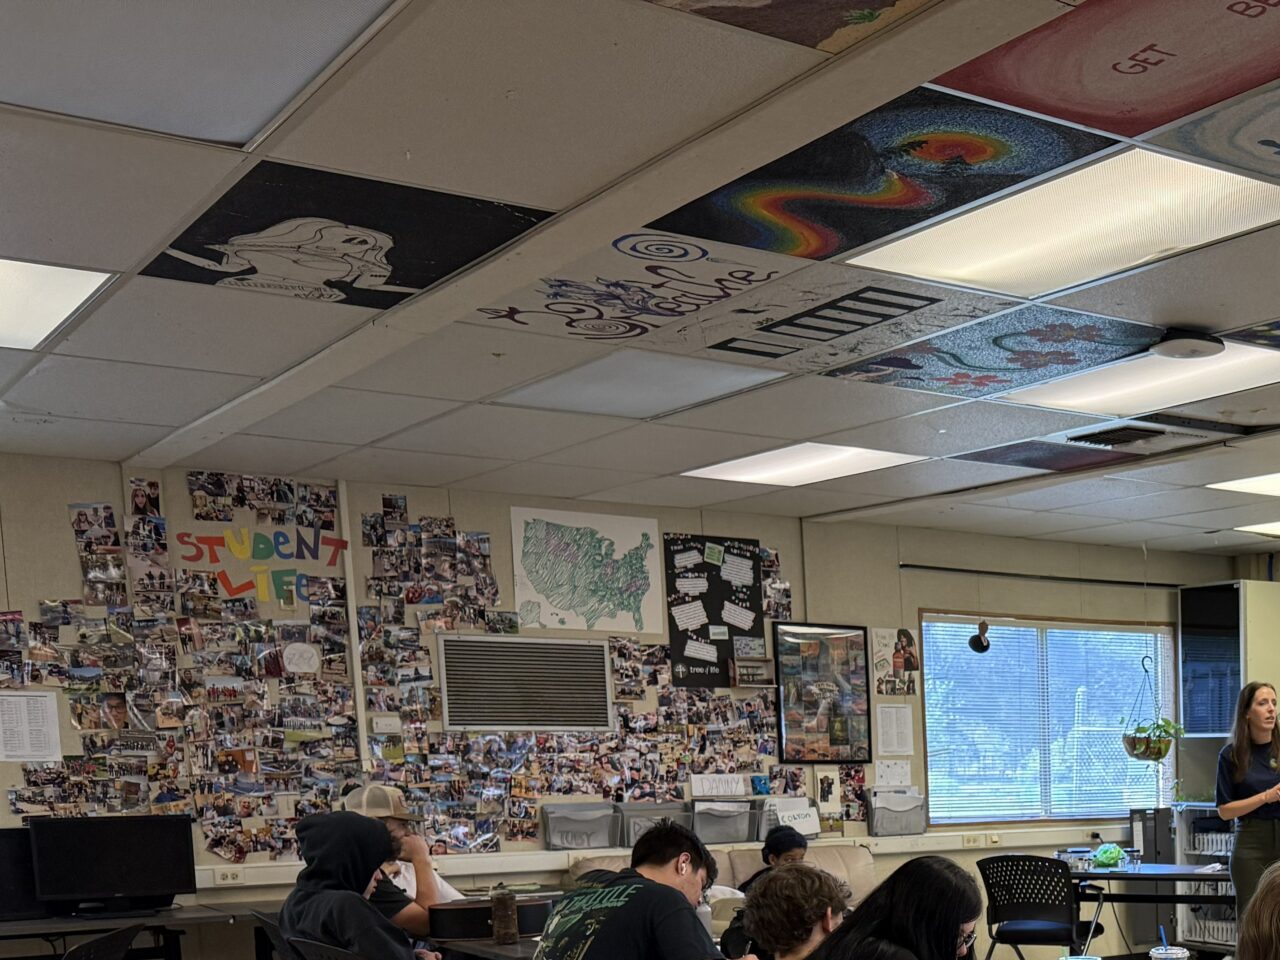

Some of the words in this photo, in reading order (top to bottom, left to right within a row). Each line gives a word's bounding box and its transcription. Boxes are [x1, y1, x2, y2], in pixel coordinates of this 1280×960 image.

[1112, 43, 1177, 75] GET
[689, 666, 705, 675] tree
[700, 776, 741, 795] DANNY
[557, 829, 597, 848] TOBY
